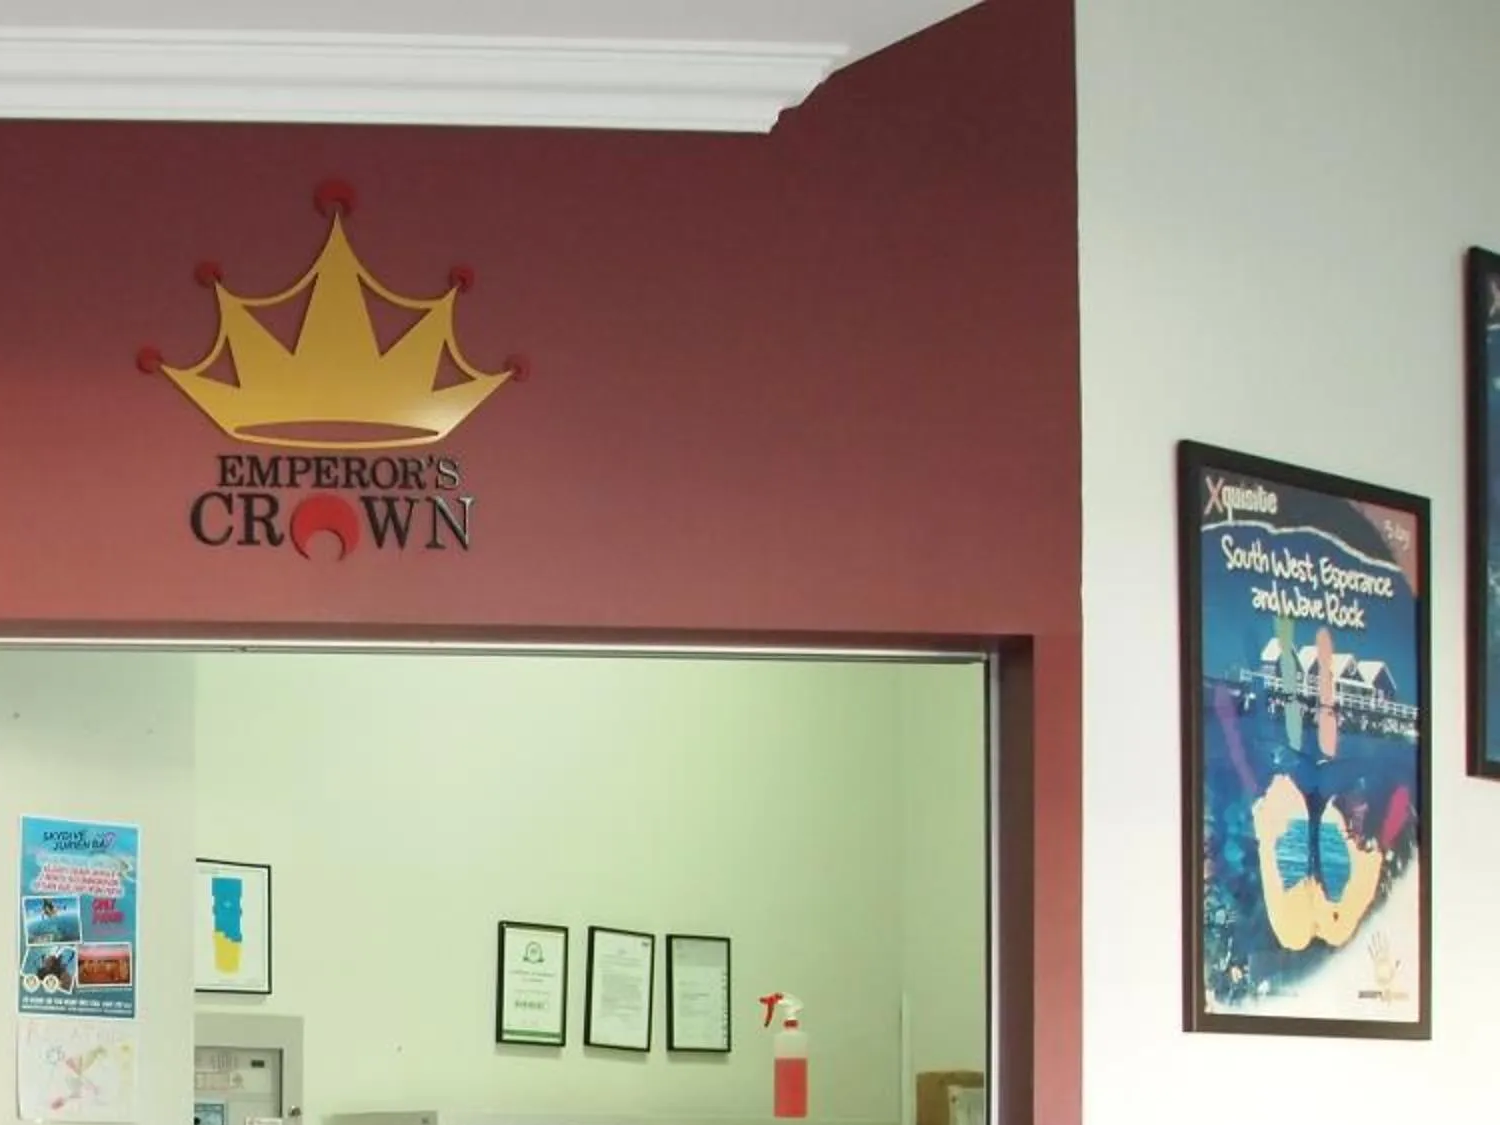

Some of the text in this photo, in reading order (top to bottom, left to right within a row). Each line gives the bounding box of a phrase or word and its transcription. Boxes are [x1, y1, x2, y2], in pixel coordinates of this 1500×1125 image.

[216, 454, 461, 489] EMPEROR'S
[189, 491, 475, 562] CROWN
[1221, 534, 1394, 598] South West, Esperance
[1251, 581, 1365, 629] and Wave Rock
